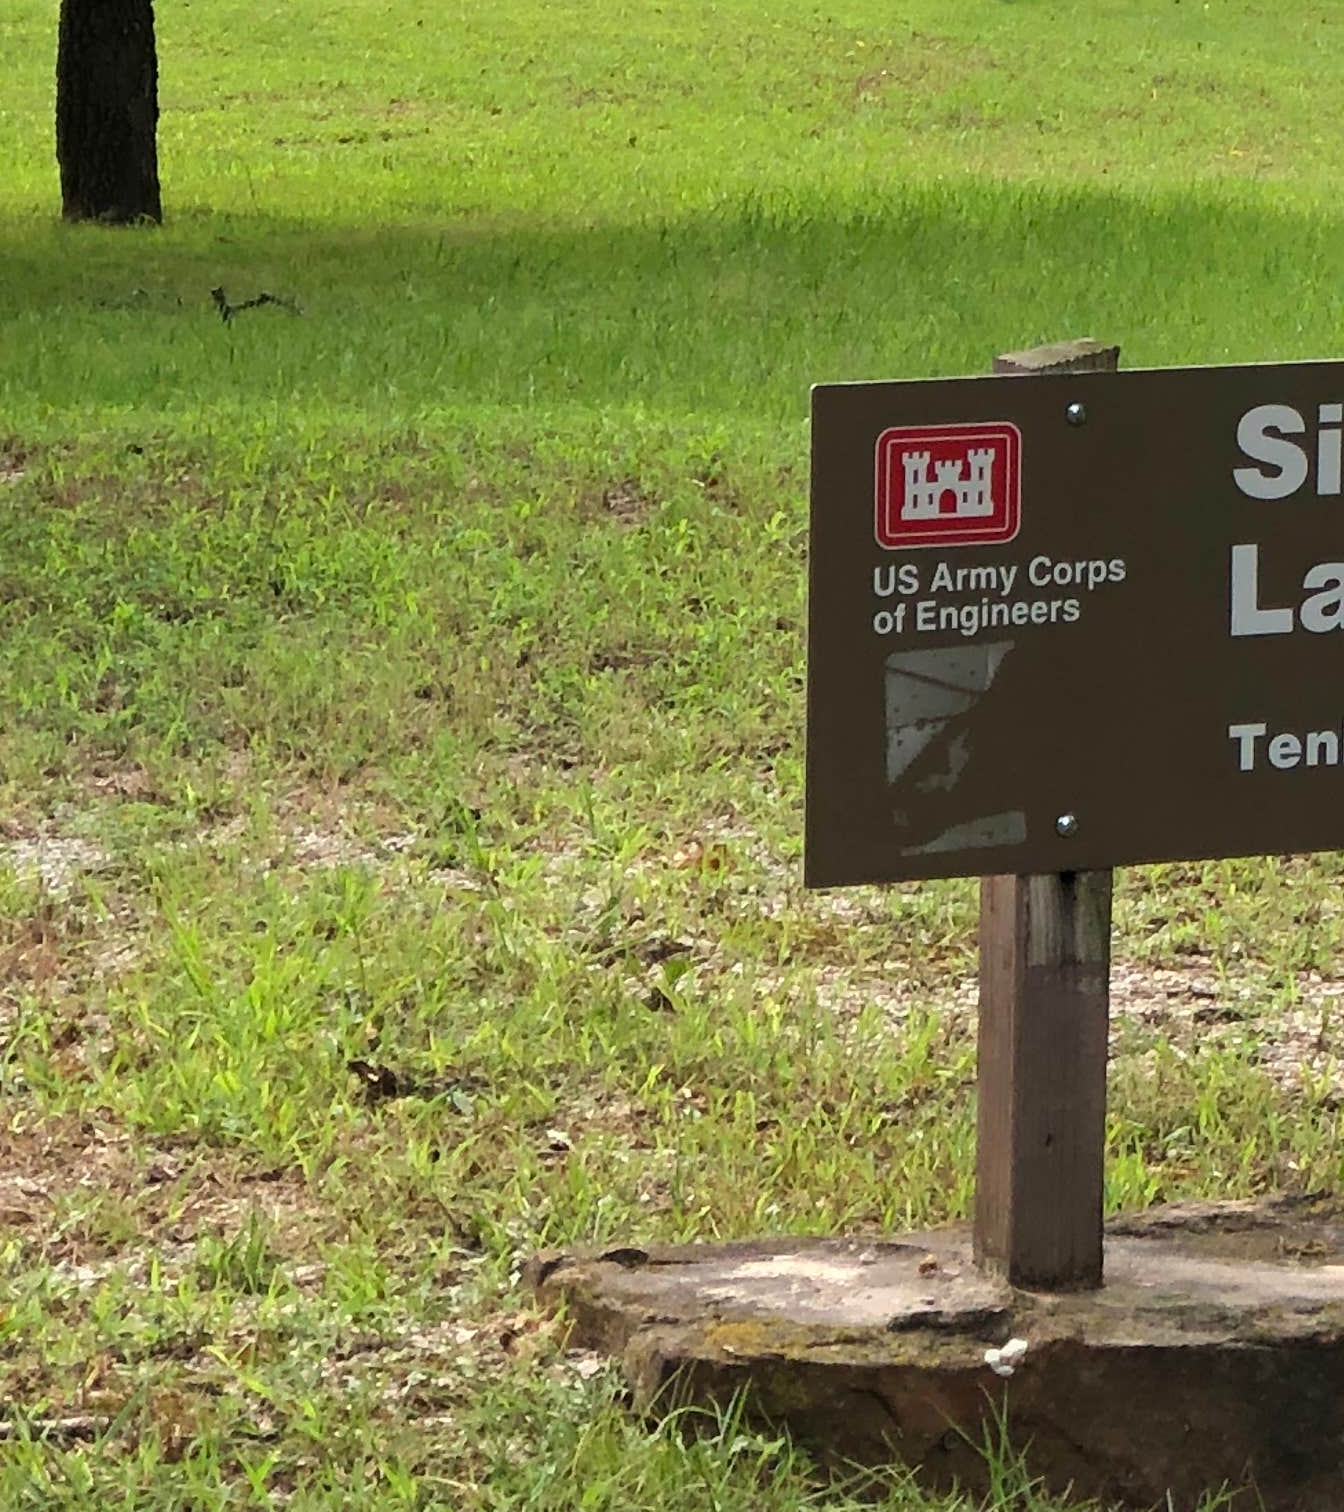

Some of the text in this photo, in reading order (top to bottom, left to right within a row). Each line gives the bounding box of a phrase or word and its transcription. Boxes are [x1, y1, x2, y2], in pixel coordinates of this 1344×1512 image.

[873, 554, 1127, 597] US Army Corps
[872, 598, 1081, 637] of Engineers
